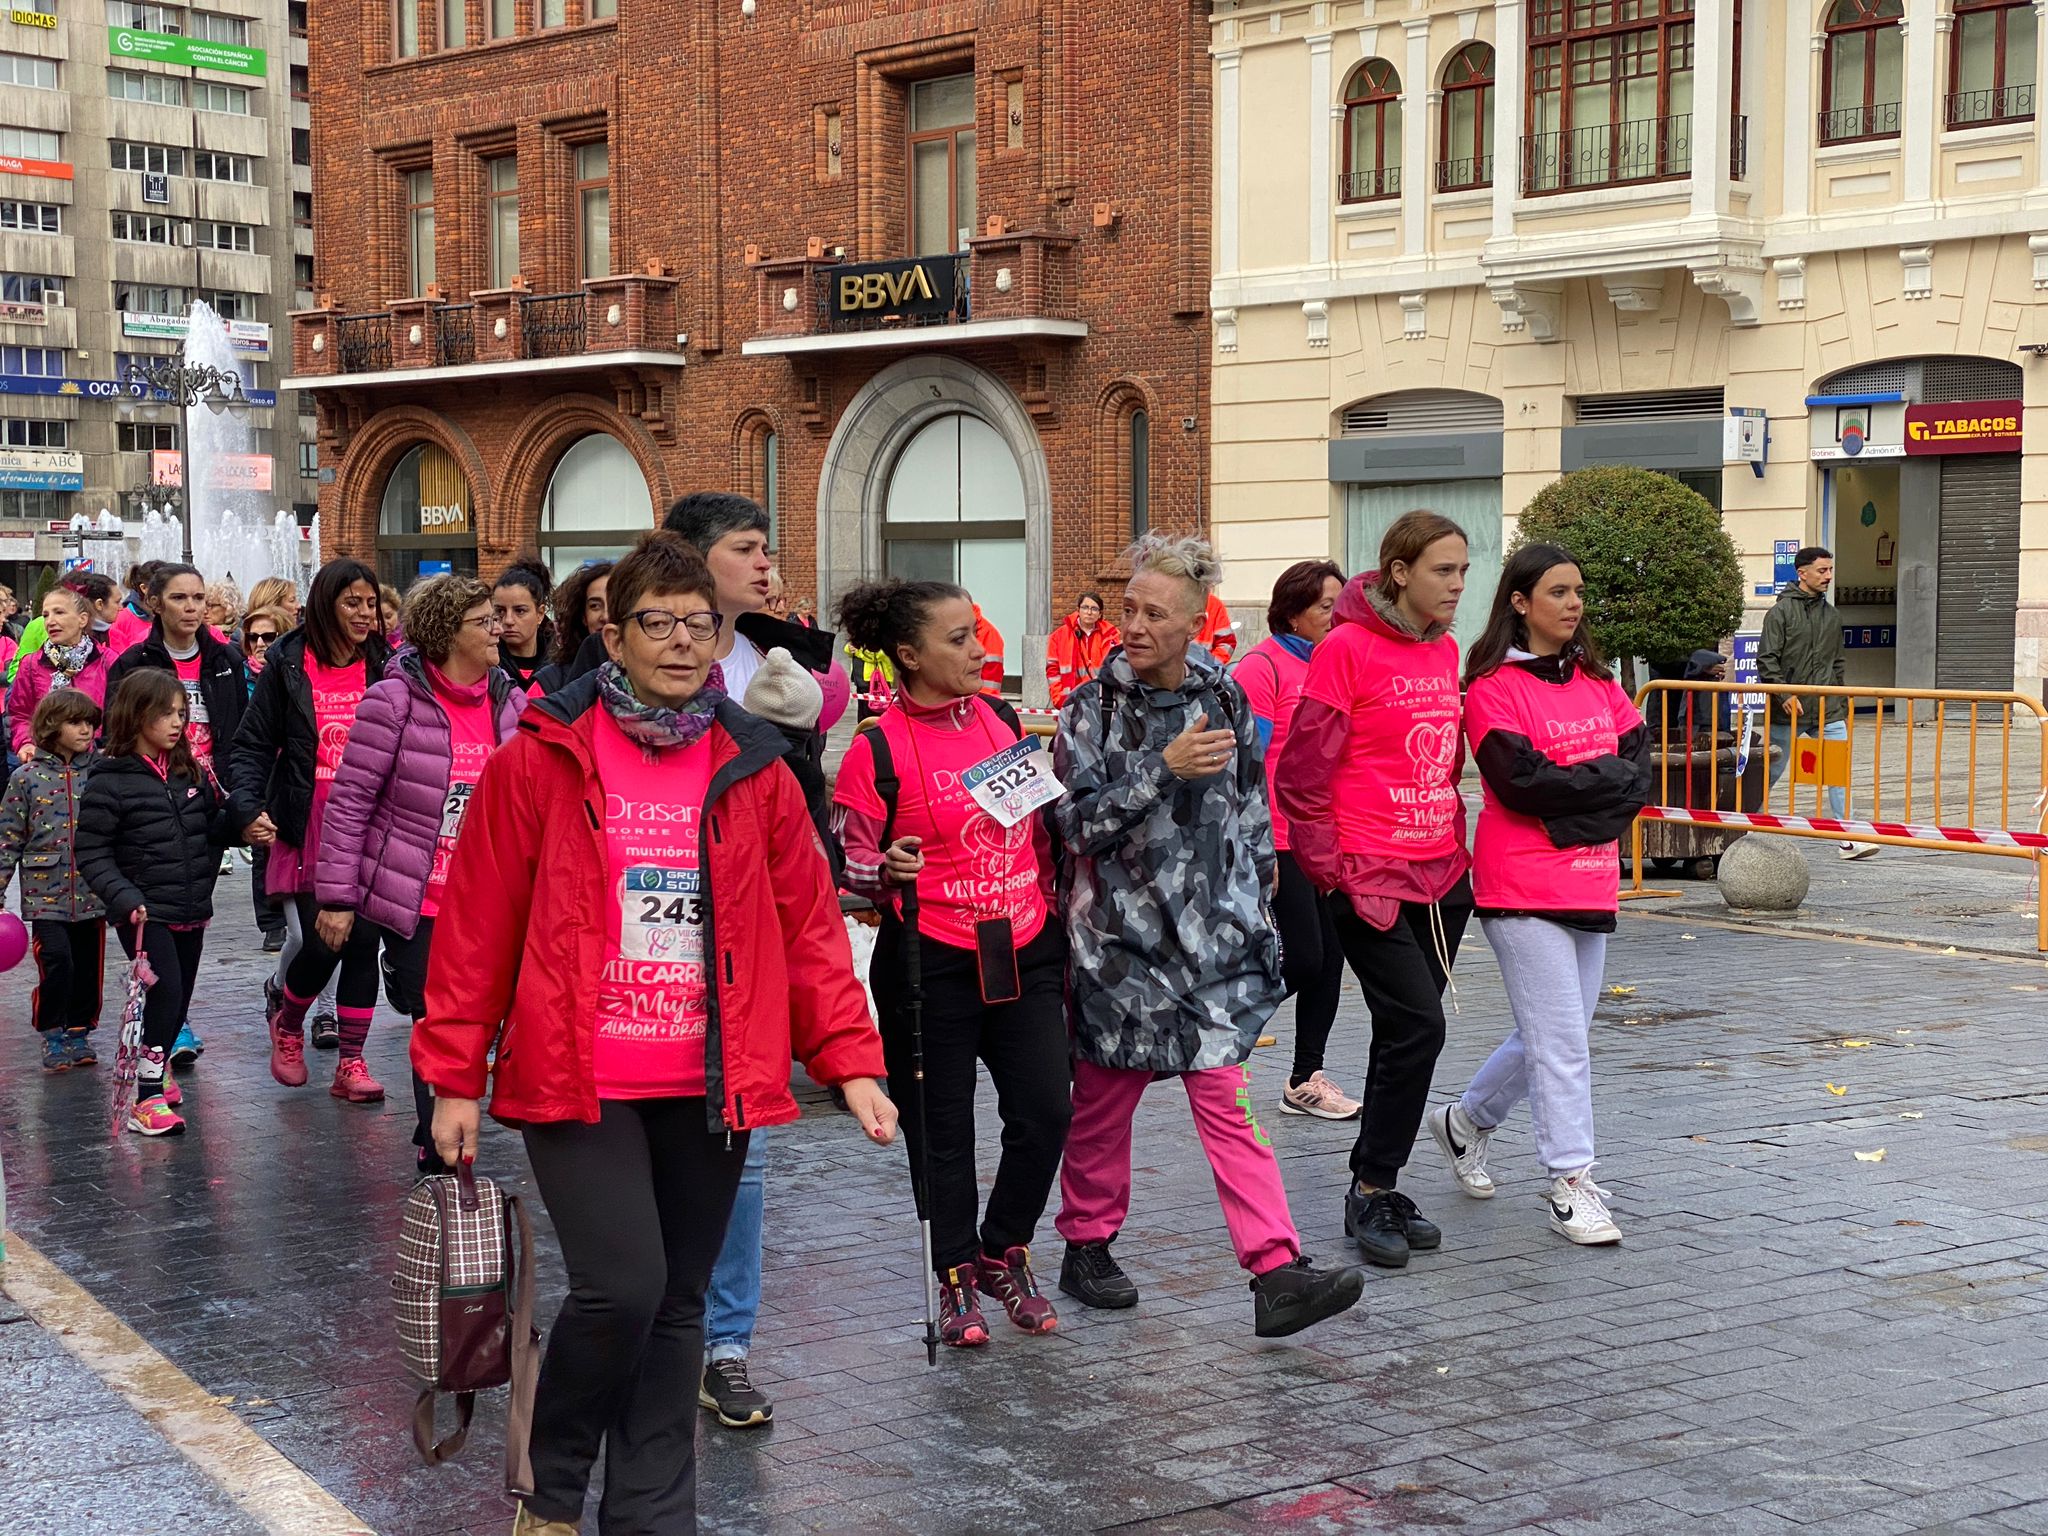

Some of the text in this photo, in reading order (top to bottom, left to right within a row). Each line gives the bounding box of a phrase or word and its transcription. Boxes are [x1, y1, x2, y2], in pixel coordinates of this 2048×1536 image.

[12, 10, 56, 27] IDIOMAS
[187, 45, 254, 61] ASOCIACIÓN ESPAÑOLA
[192, 54, 217, 63] CONTRA
[224, 58, 248, 68] CÁNCER
[840, 264, 933, 311] BBVA
[149, 315, 190, 326] Abogados
[89, 382, 141, 397] OCAO
[929, 384, 942, 398] 3
[1934, 416, 2017, 434] TABACOS
[1811, 449, 1836, 457] Botines
[1865, 446, 1889, 455] Admón
[48, 455, 77, 468] ABC
[0, 471, 45, 485] nformativa
[421, 502, 464, 526] BBVA
[1744, 641, 1760, 653] HA
[1734, 658, 1758, 671] LOTE
[1731, 692, 1766, 705] NVIDA
[1546, 706, 1614, 739] Drasanvi
[986, 758, 1037, 799] 5123
[1389, 787, 1417, 804] VIII
[1392, 829, 1428, 839] ALMOM
[1571, 858, 1604, 869] ALMOM
[943, 868, 1037, 898] VIII CARRERA
[600, 1019, 657, 1036] ALMOM
